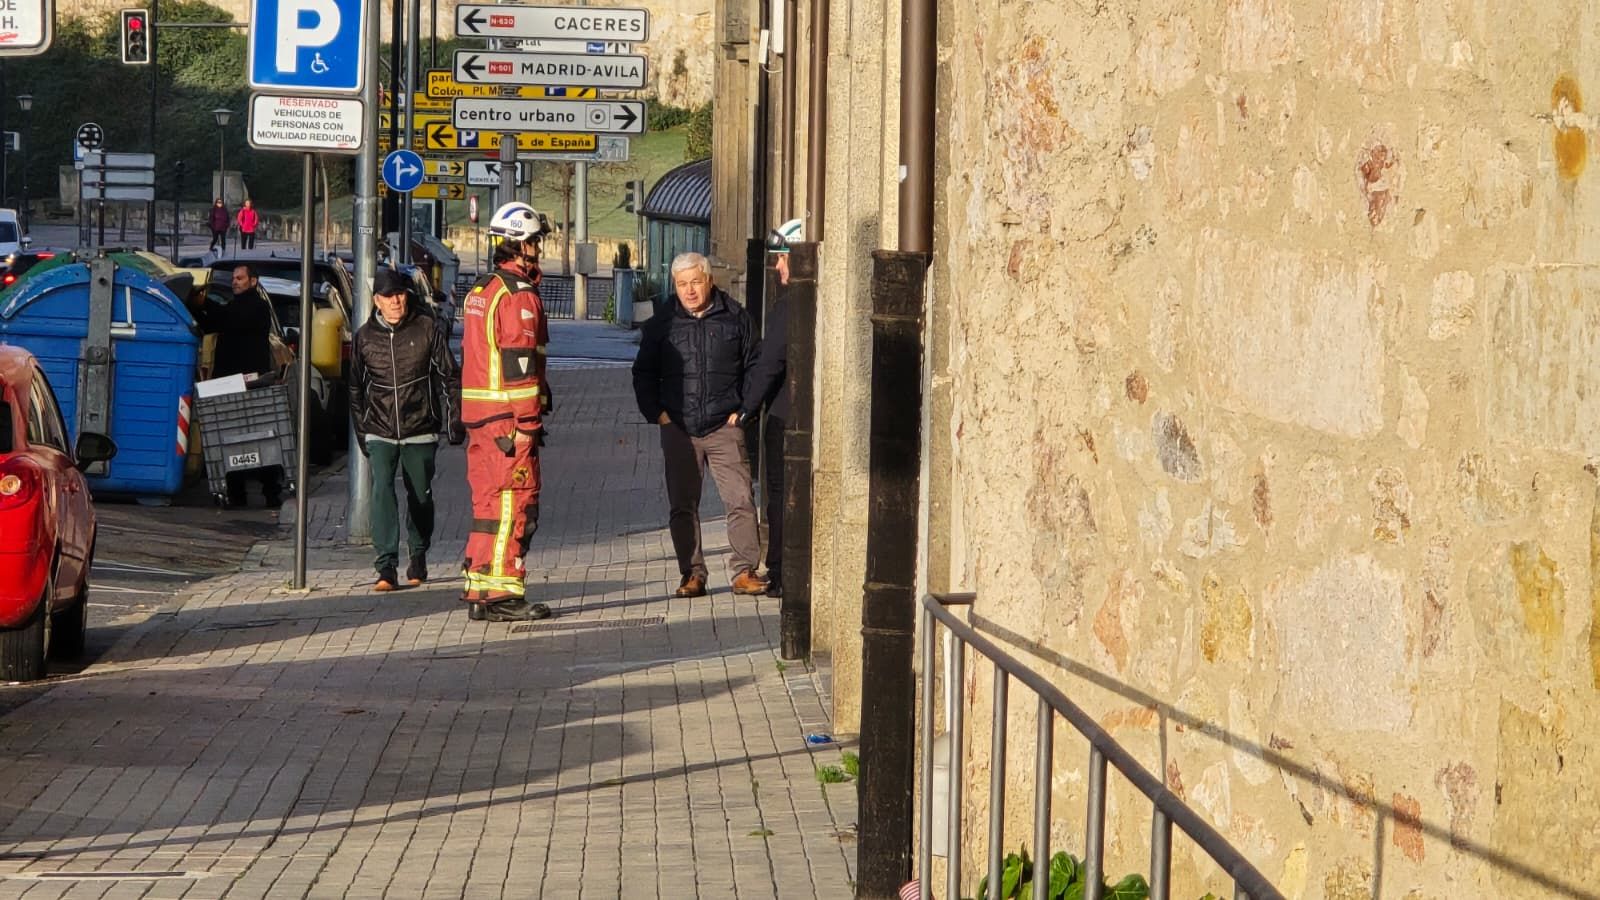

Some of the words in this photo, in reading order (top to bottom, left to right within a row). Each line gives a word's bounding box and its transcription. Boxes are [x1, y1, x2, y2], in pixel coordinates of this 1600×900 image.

[554, 16, 641, 32] CACERES
[275, 0, 341, 73] P
[521, 62, 640, 78] MADRID-AVILA
[432, 86, 464, 96] Colón
[279, 98, 338, 109] RESERVADO
[274, 108, 327, 119] VEHICULOS
[328, 111, 342, 119] DE
[459, 107, 512, 122] centro
[519, 108, 576, 123] urbano
[271, 119, 321, 130] PERSONAS
[323, 122, 344, 131] CON
[257, 130, 307, 141] MOVILIDAD
[309, 132, 357, 143] REDUCIDA
[460, 131, 477, 147] P
[531, 136, 544, 147] de
[551, 136, 591, 149] España
[232, 454, 257, 465] 0445
